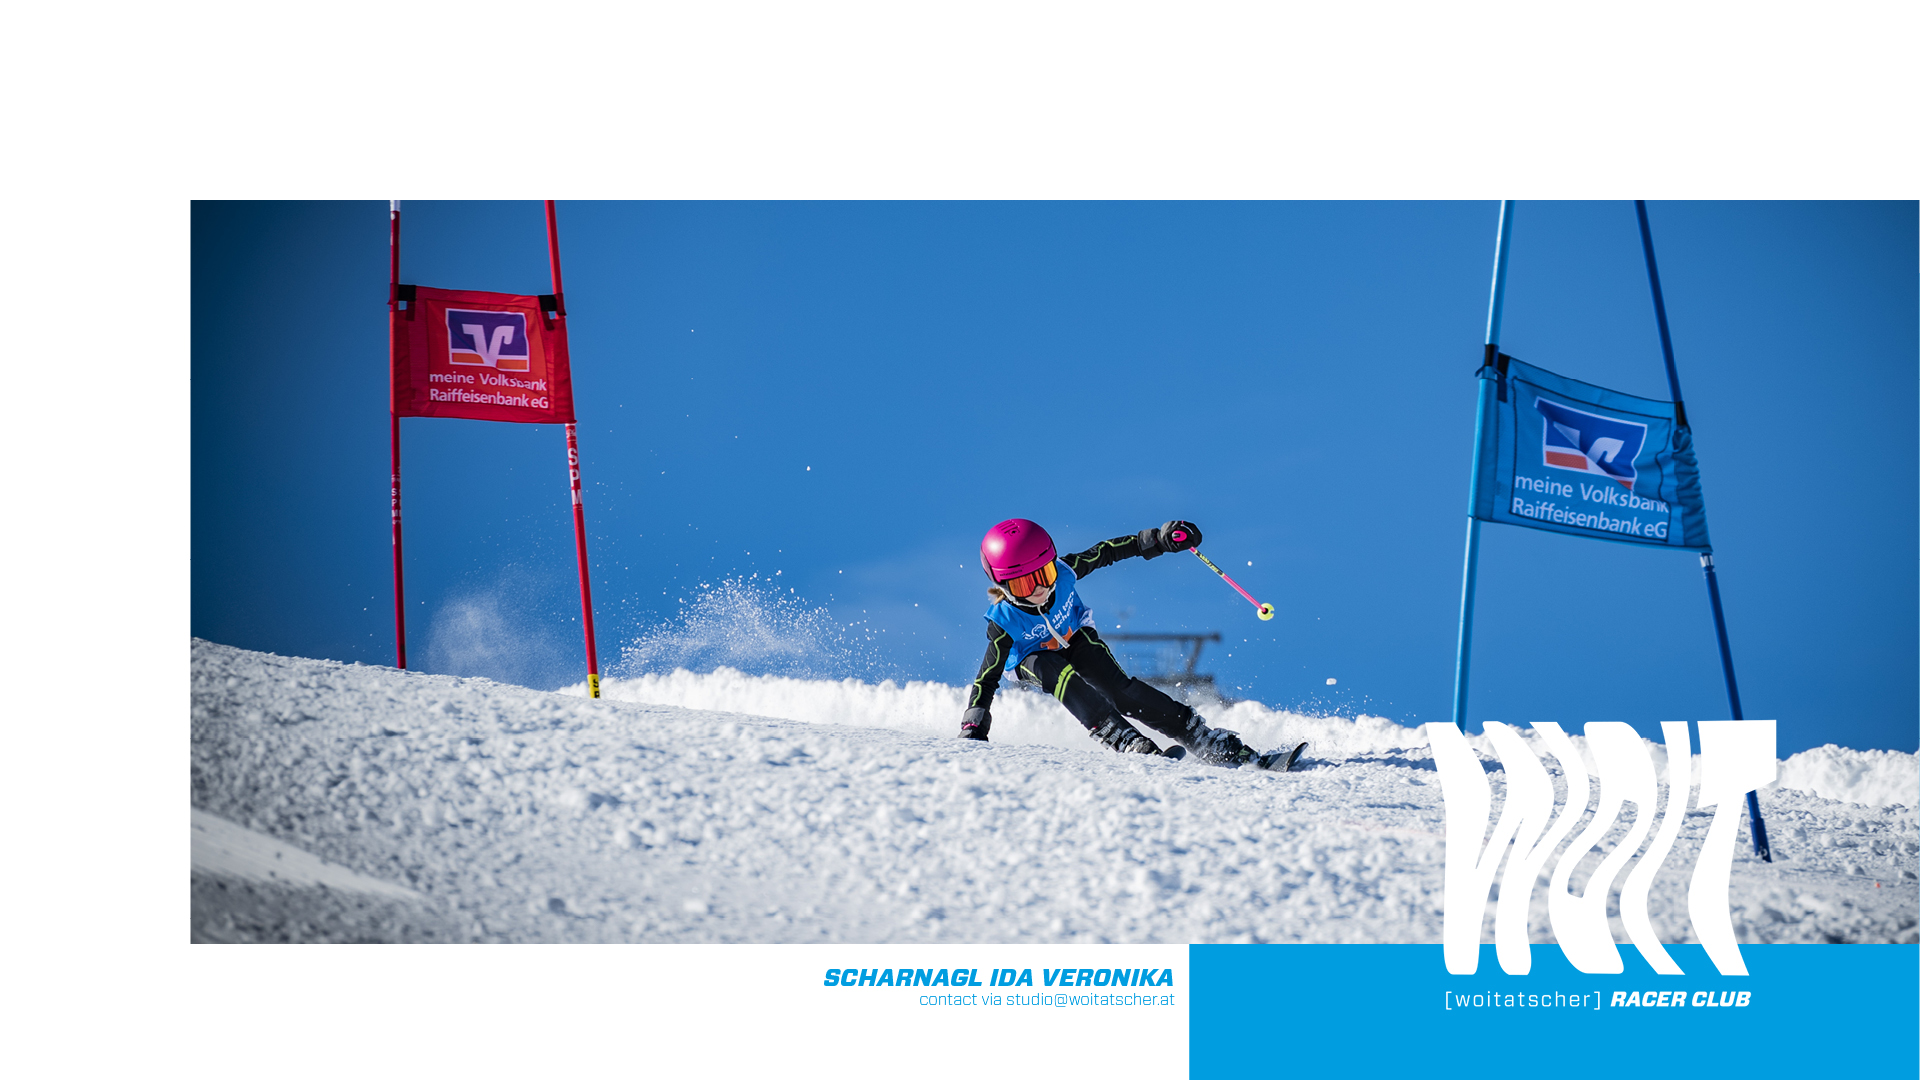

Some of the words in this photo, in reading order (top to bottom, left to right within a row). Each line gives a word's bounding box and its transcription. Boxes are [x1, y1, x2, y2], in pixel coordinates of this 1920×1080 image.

[429, 371, 475, 385] meine
[479, 373, 547, 391] Volksbank
[429, 389, 529, 408] Raiffeisenbank
[530, 396, 549, 410] eG
[1514, 475, 1573, 498] meine
[1579, 482, 1670, 513] Volksbank
[1511, 497, 1642, 535] Raiffeisenbank
[1643, 520, 1669, 539] eG
